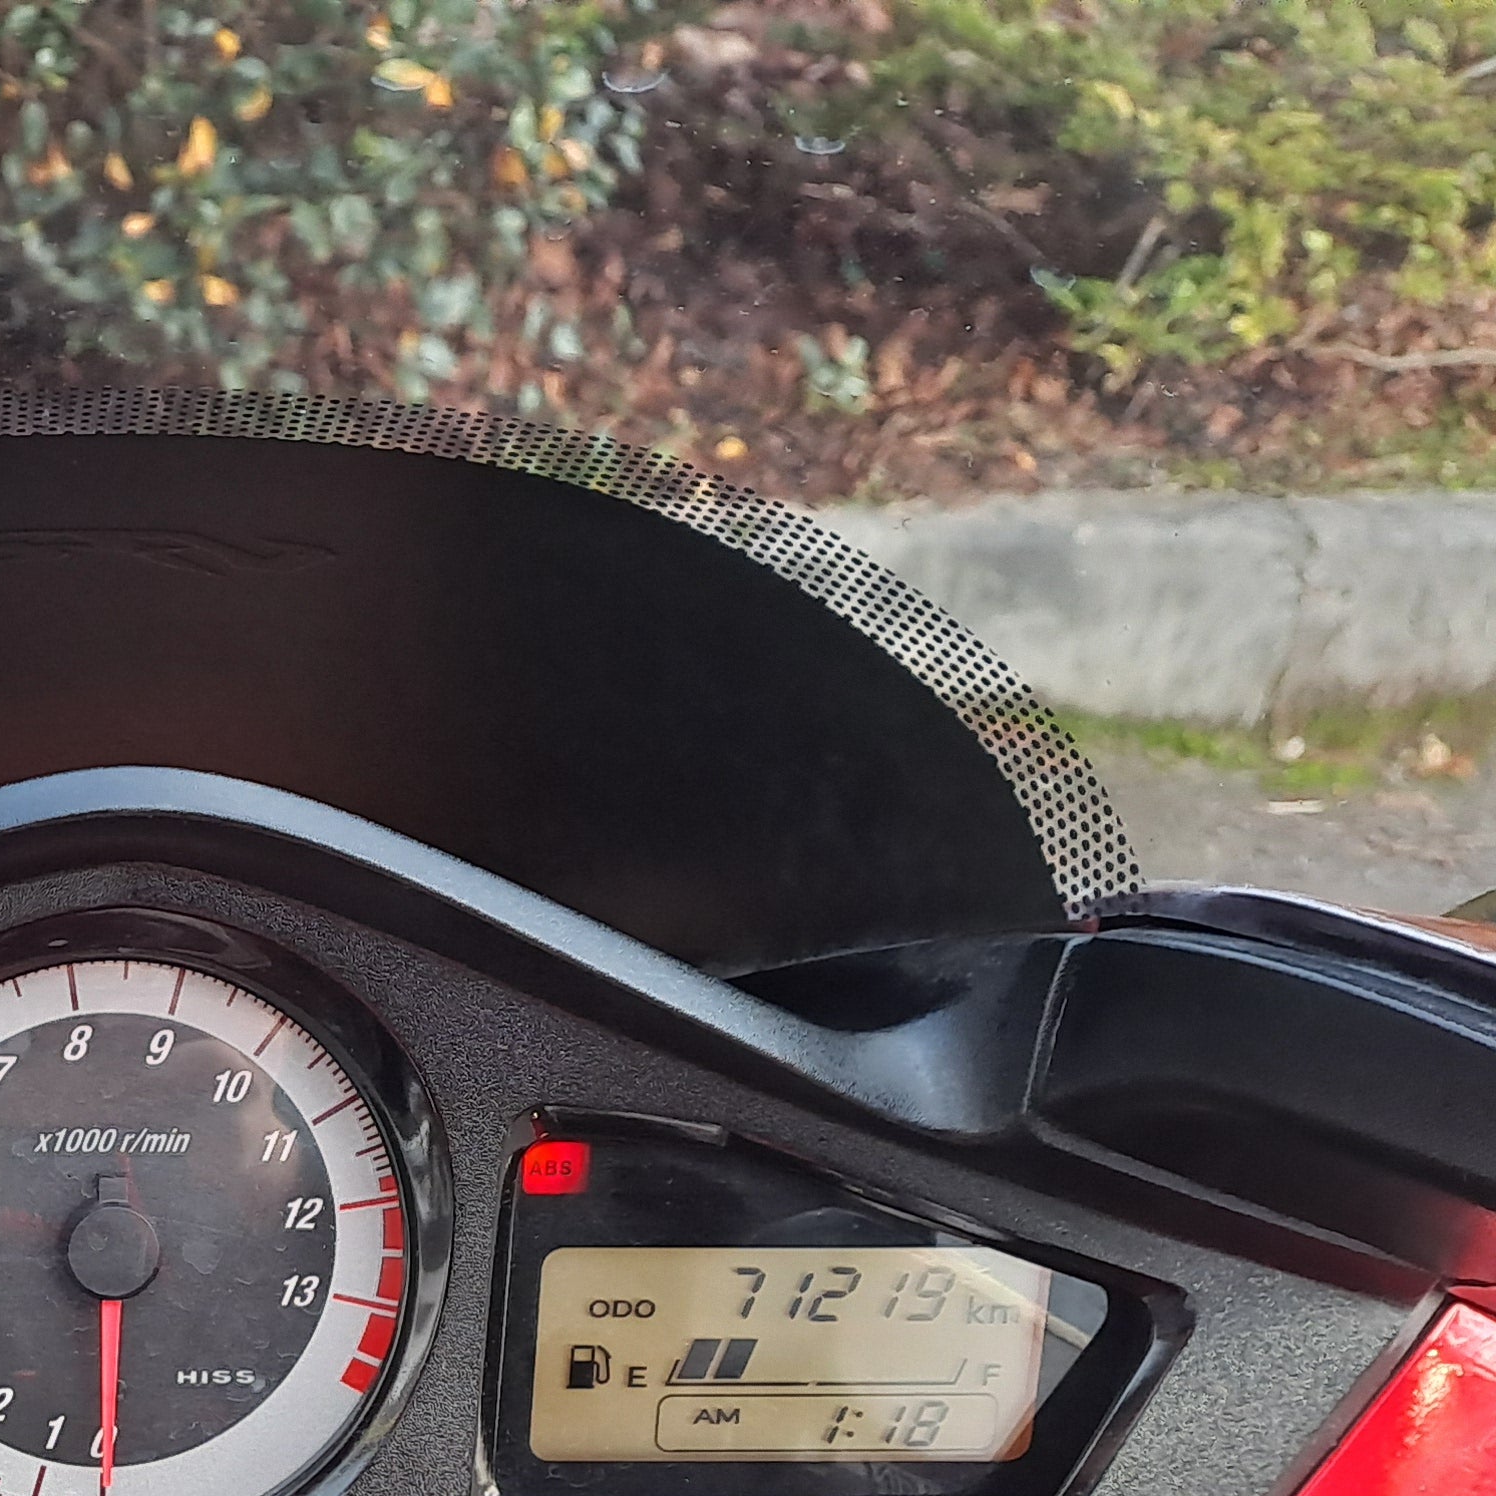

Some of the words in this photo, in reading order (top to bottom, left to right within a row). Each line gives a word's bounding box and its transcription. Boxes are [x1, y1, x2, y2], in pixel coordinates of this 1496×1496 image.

[62, 1024, 93, 1062] 8
[144, 1028, 175, 1066] 9
[211, 1069, 253, 1104] 10
[33, 1128, 116, 1154] x1000
[120, 1128, 191, 1154] r/min
[260, 1129, 298, 1162] 11
[529, 1159, 574, 1177] ABS
[282, 1197, 324, 1231] 12
[280, 1275, 319, 1308] 13
[730, 1266, 958, 1322] 71219
[965, 1297, 1021, 1326] km
[588, 1299, 656, 1320] ODO
[175, 1368, 257, 1386] HISS
[628, 1366, 647, 1389] E
[980, 1363, 1002, 1387] F
[44, 1415, 66, 1450] 1
[692, 1406, 741, 1426] AM
[820, 1400, 951, 1447] 1:18
